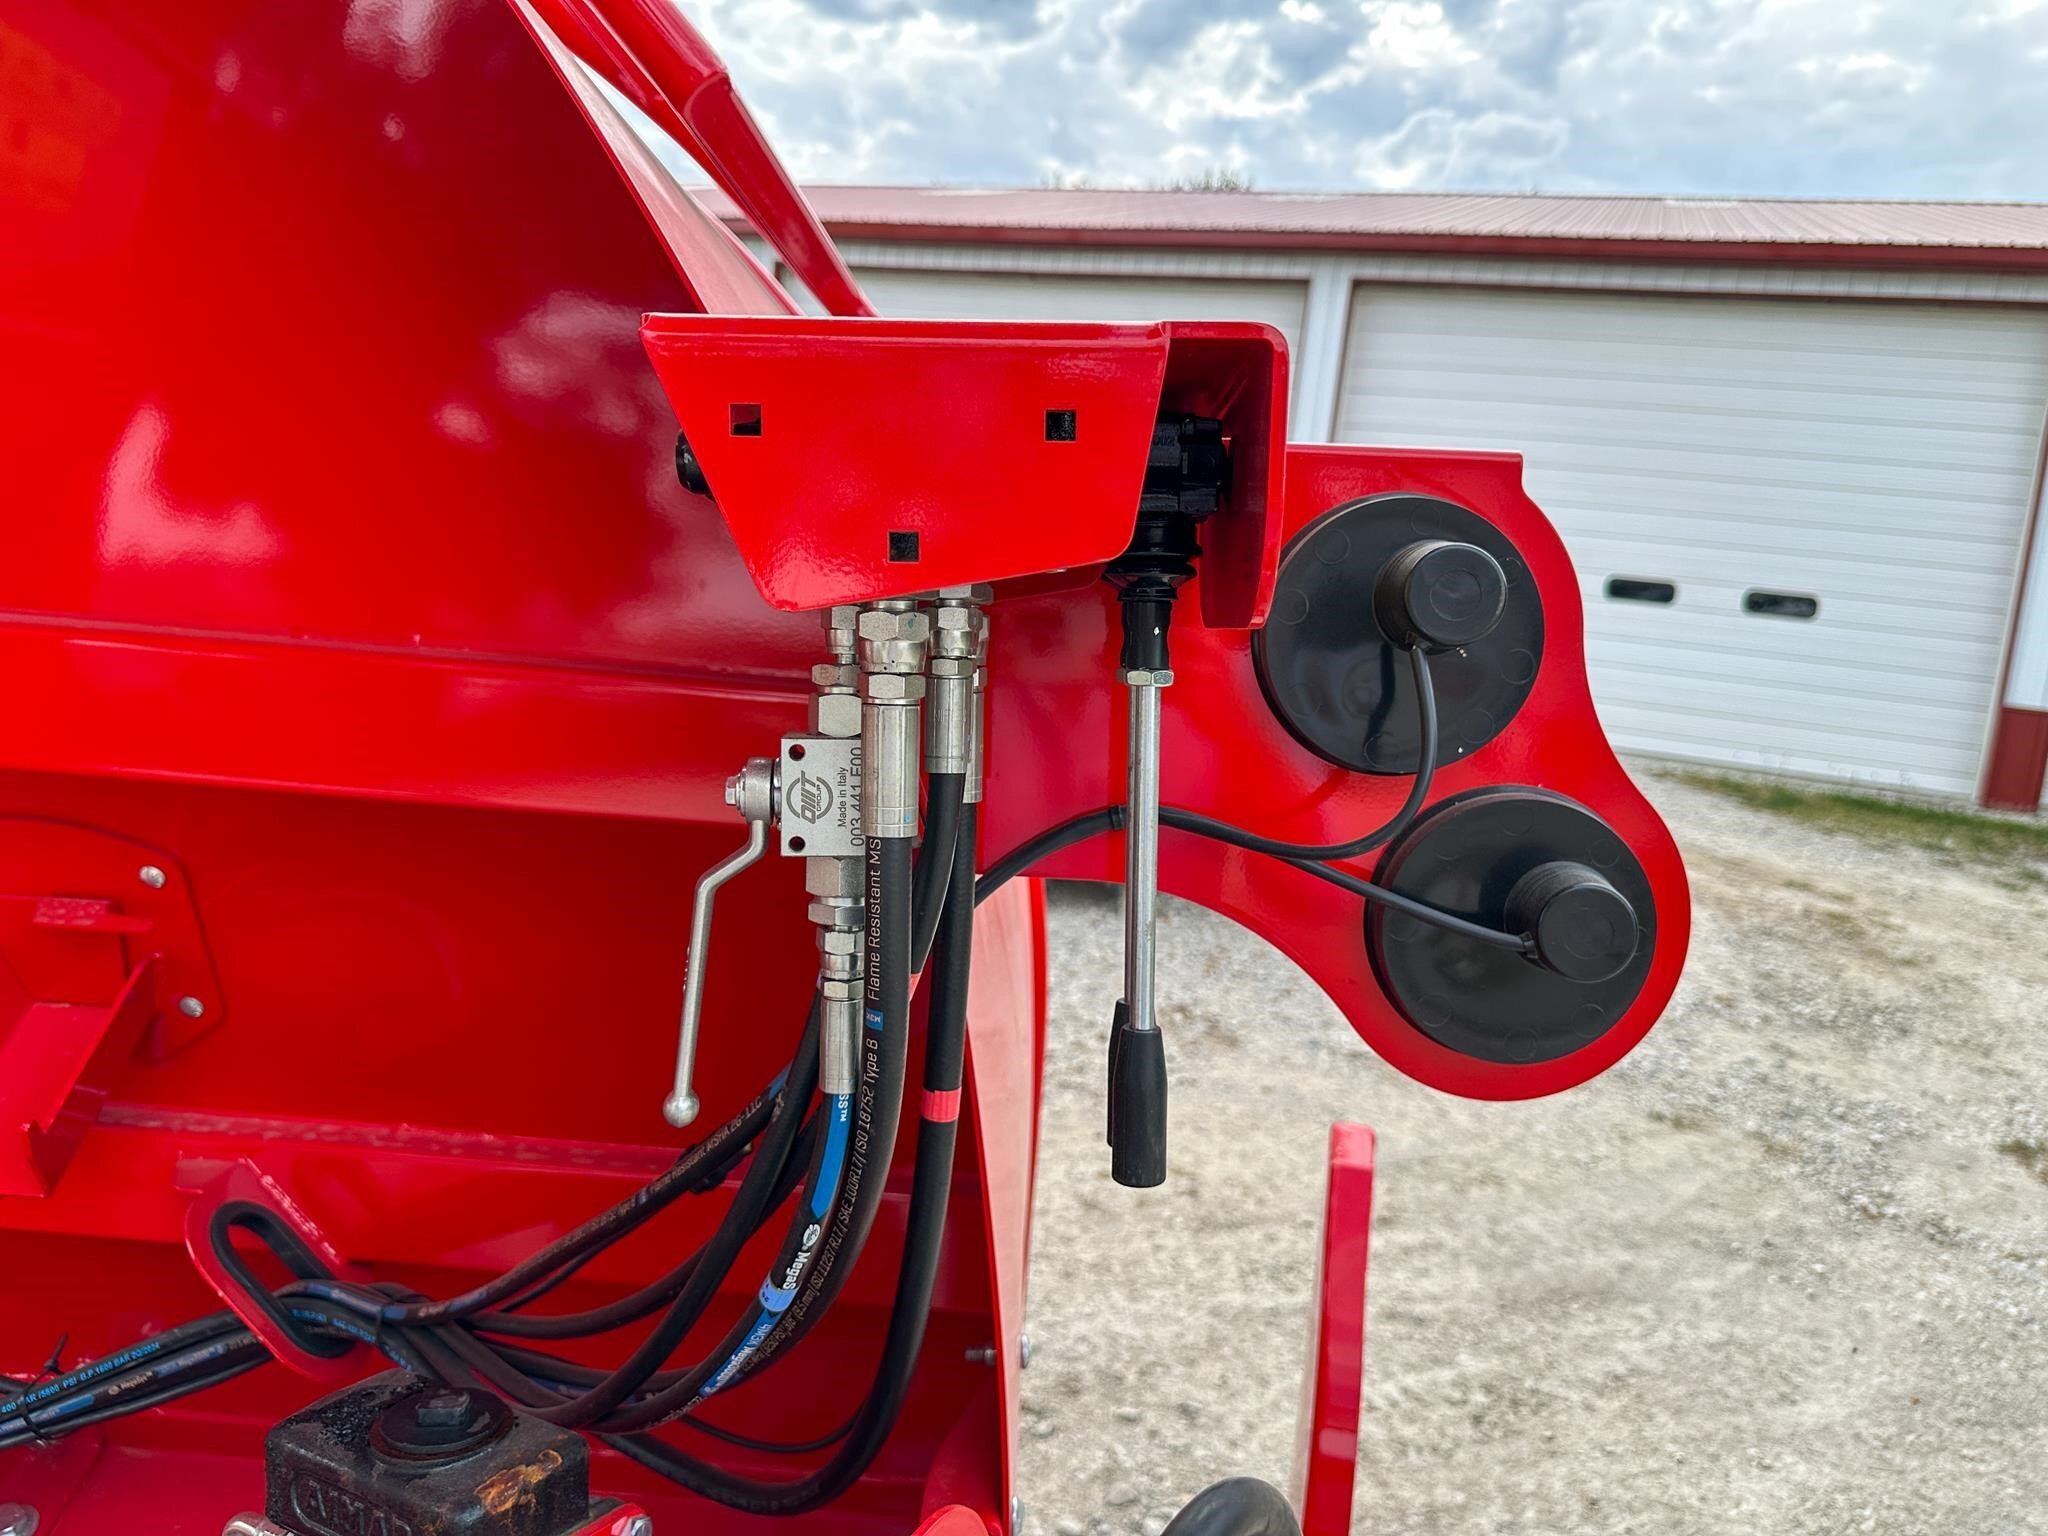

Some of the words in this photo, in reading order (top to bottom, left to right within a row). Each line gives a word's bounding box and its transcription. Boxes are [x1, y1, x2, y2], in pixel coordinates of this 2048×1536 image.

[838, 767, 849, 787] Italy
[838, 790, 847, 798] in
[838, 801, 847, 828] Made
[868, 869, 881, 947] Resistant
[868, 952, 880, 1000] Flame
[866, 1038, 878, 1050] B
[863, 1052, 880, 1084] Type
[859, 1085, 875, 1131] 18752
[855, 1130, 869, 1153] ISO
[838, 1200, 854, 1224] SAE
